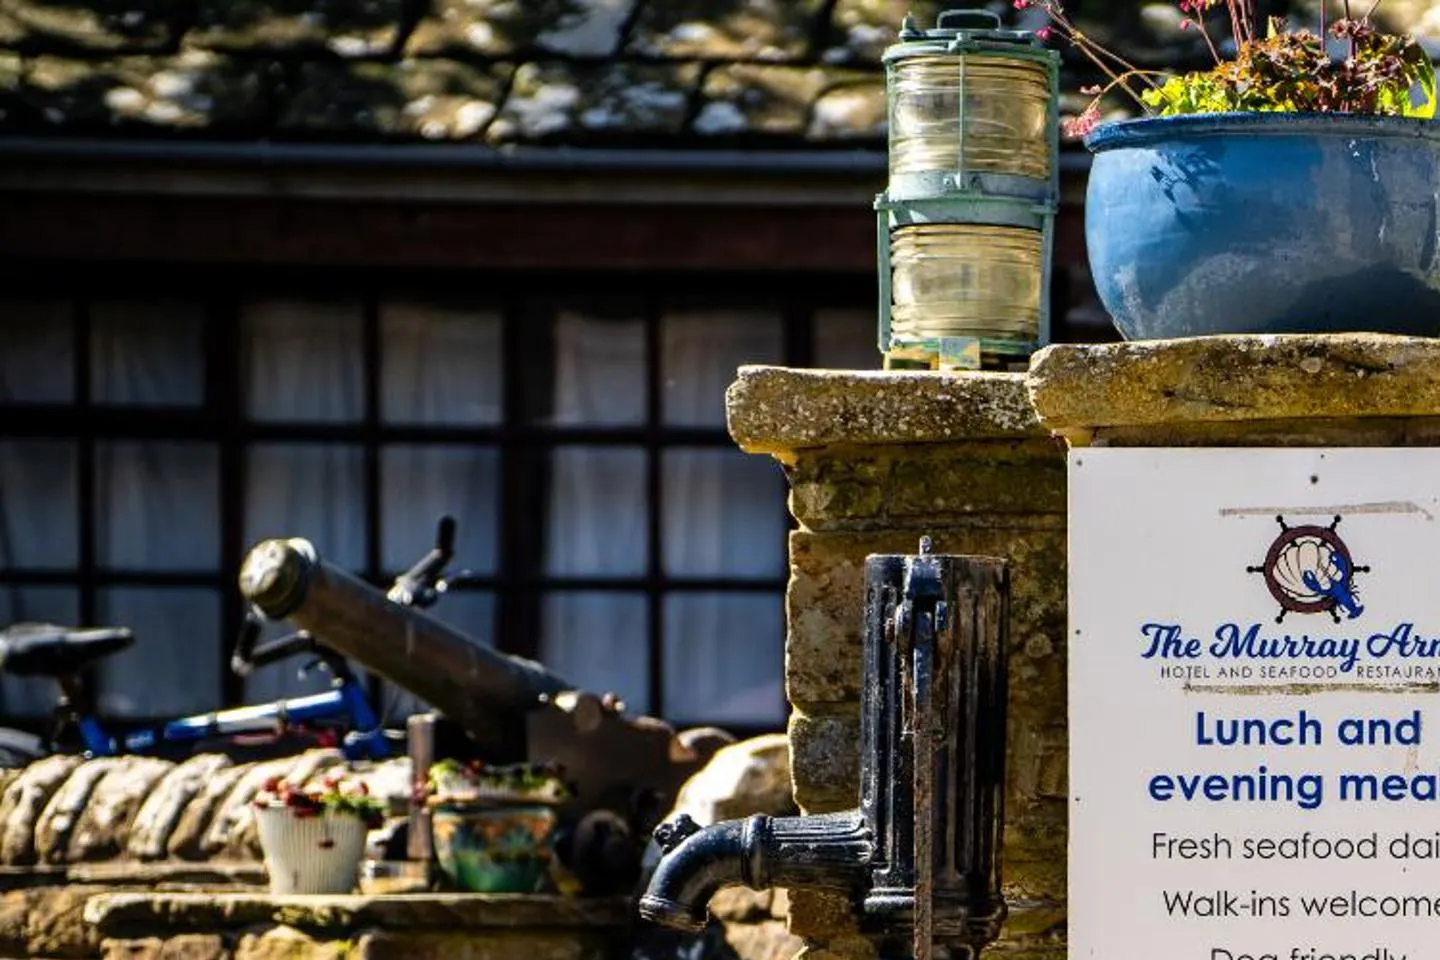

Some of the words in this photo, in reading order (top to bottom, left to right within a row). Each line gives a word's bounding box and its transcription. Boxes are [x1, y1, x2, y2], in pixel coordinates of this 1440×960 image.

[1141, 623, 1202, 659] The
[1209, 623, 1361, 673] Murray
[1160, 665, 1211, 680] HOTEL
[1216, 665, 1253, 680] AND
[1259, 665, 1338, 680] SEAFOOD
[1196, 710, 1322, 746] Lunch
[1337, 710, 1422, 746] and
[1148, 765, 1323, 811] evening
[1152, 832, 1232, 860] Fresh
[1242, 831, 1378, 860] seafood
[1162, 889, 1290, 917] Walk-ins
